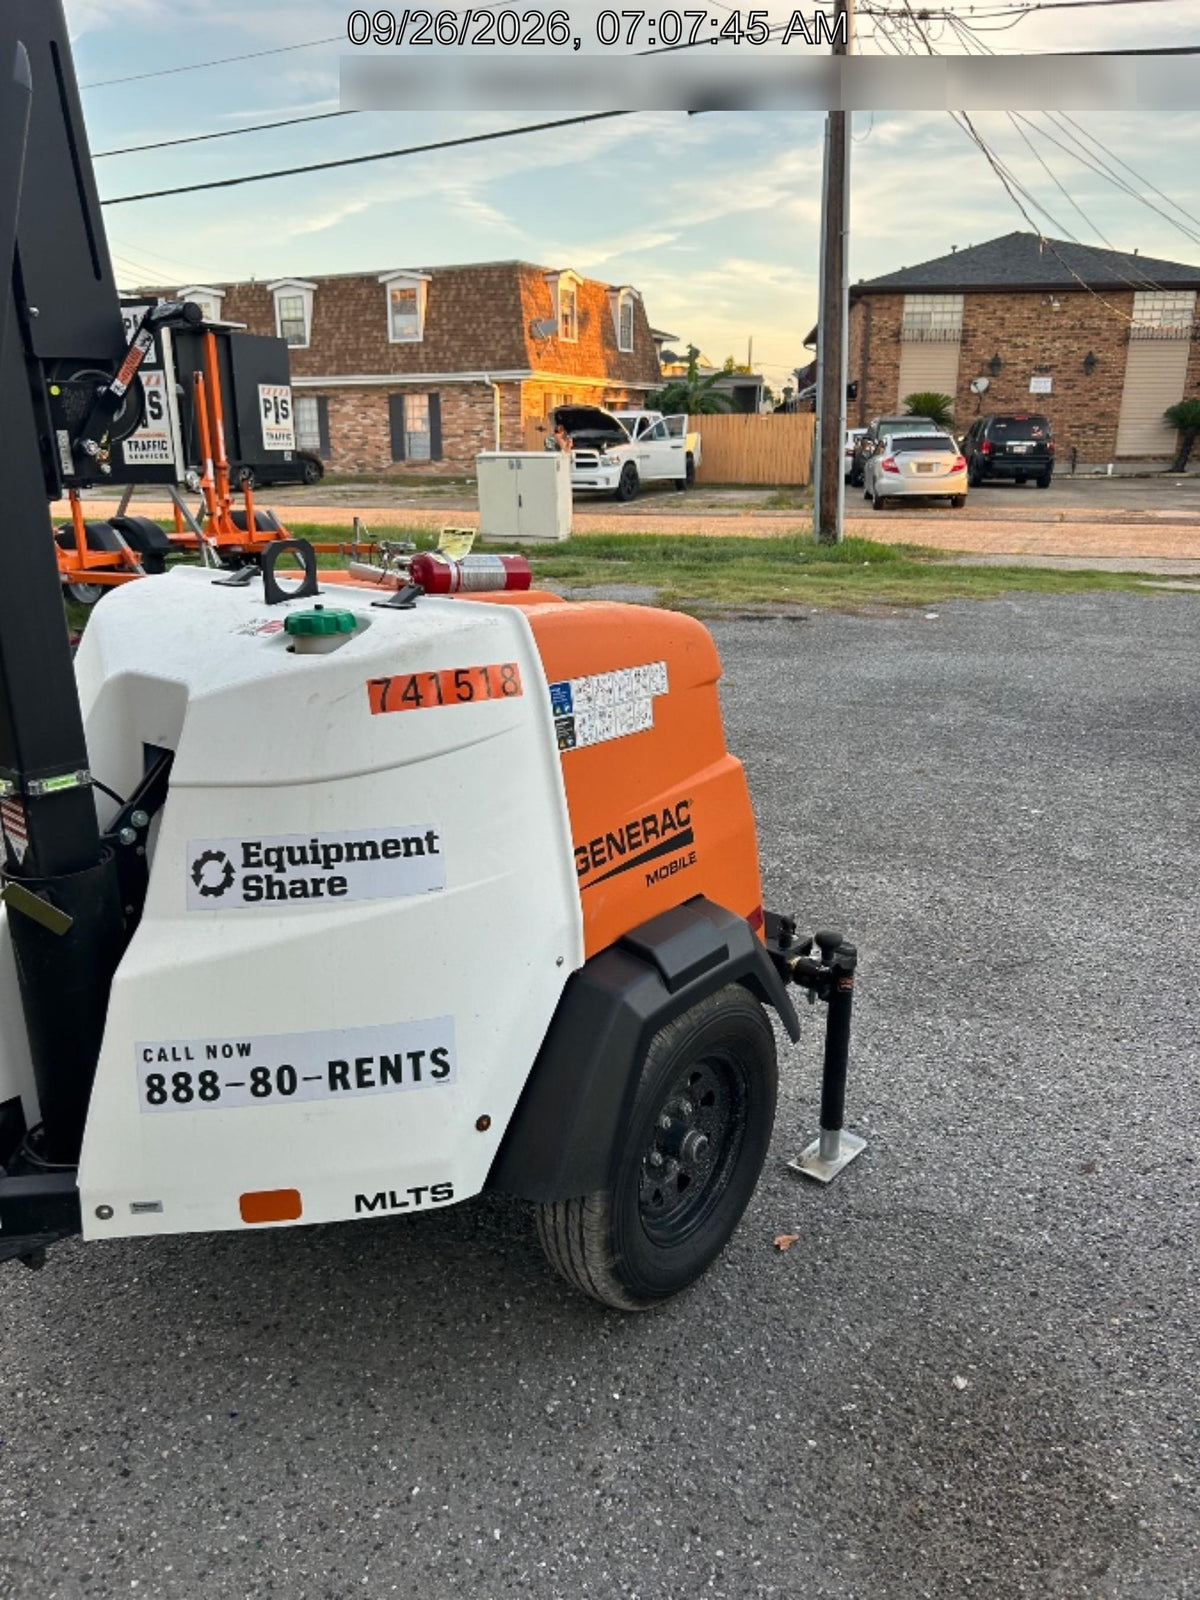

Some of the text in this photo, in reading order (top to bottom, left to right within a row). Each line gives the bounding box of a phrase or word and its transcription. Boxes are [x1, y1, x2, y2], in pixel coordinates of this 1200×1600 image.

[127, 440, 168, 452] TRAFFIC
[370, 663, 518, 712] 741518
[241, 830, 440, 873] Equipment
[574, 799, 691, 877] GENERAC
[241, 874, 348, 902] Share
[645, 851, 697, 888] MOBILE
[143, 1043, 252, 1062] CALL NOW
[145, 1047, 451, 1105] 888-80-RENTS
[355, 1182, 453, 1213] MLTS
